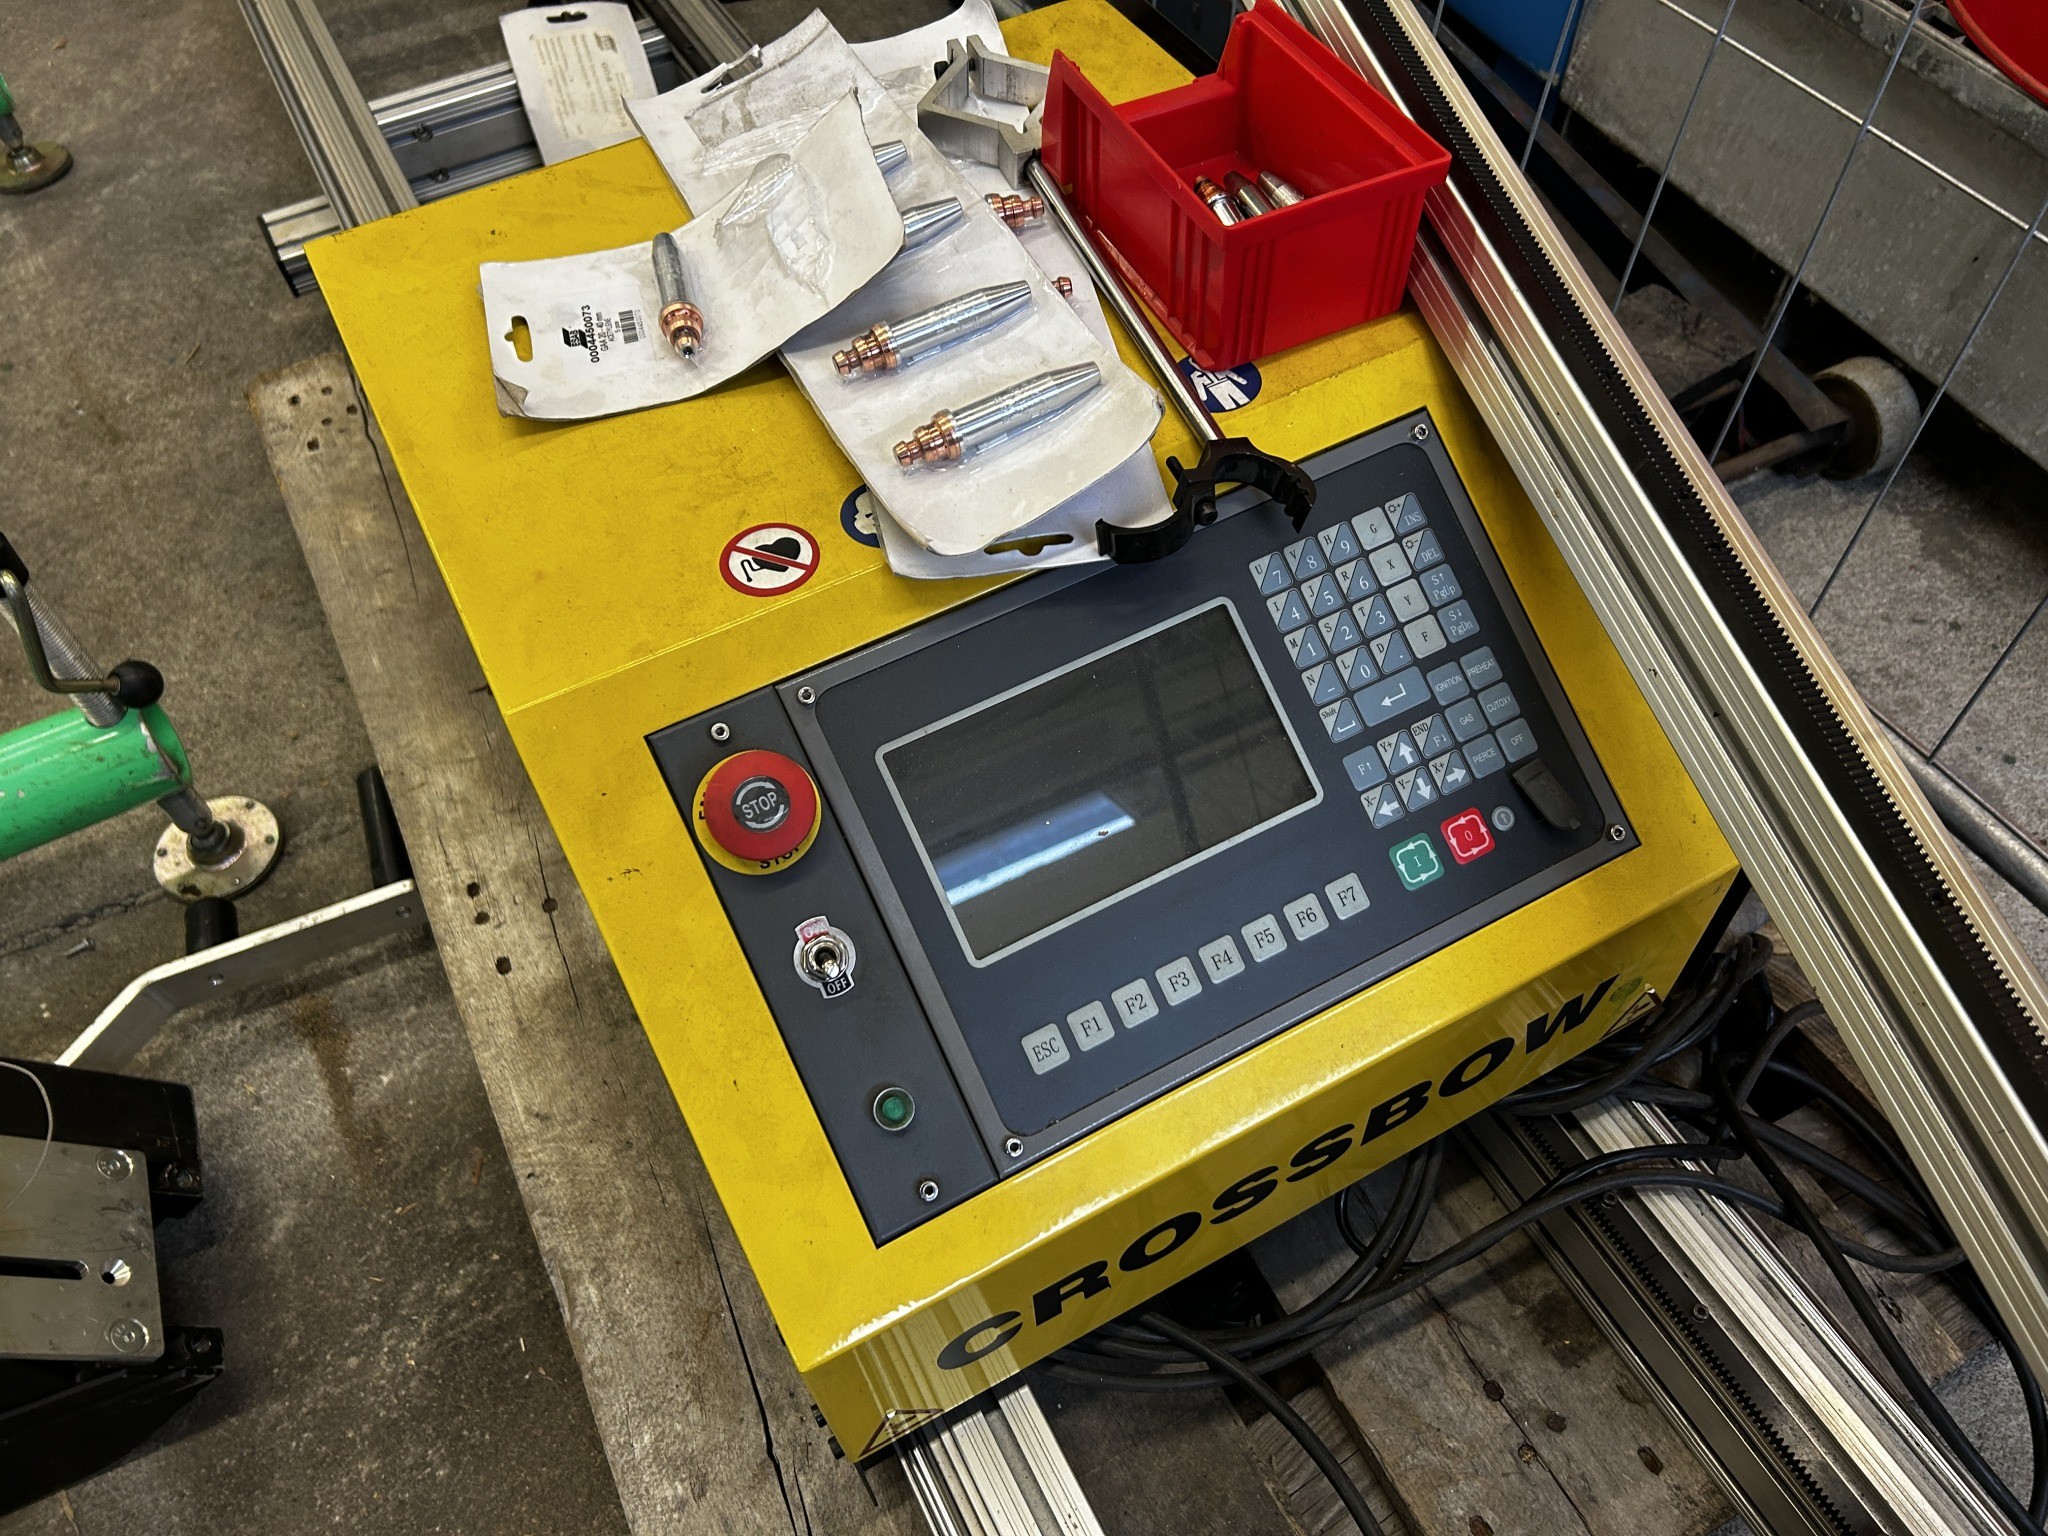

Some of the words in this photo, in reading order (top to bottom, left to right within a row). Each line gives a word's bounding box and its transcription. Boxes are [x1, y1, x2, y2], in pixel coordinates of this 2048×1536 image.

[570, 329, 581, 347] ESAB
[581, 304, 600, 363] 0004450073
[1404, 511, 1422, 526] INS
[1369, 523, 1378, 534] G
[1323, 534, 1333, 545] H
[1341, 540, 1350, 554] 9
[1289, 550, 1297, 560] V
[1306, 555, 1317, 570] 8
[1421, 547, 1440, 563] DEL
[1255, 564, 1263, 575] U
[1387, 559, 1396, 570] X
[1273, 570, 1282, 584] 7
[1341, 570, 1350, 581] R
[1360, 576, 1369, 590] 6
[1308, 585, 1315, 598] J
[1323, 591, 1334, 606] 5
[1433, 585, 1456, 600] PgUp
[1273, 601, 1280, 612] I
[1404, 595, 1411, 606] Y
[1292, 607, 1300, 620] 4
[1358, 606, 1366, 617] T
[1375, 610, 1386, 625] 3
[1324, 622, 1332, 633] S
[1341, 626, 1353, 640] 2
[1450, 620, 1474, 636] PgDn
[1289, 638, 1299, 649] M
[1421, 631, 1428, 642] F
[1306, 642, 1316, 657] 1
[1376, 643, 1384, 653] D
[1341, 659, 1350, 670] L
[1360, 664, 1370, 679] 0
[1466, 659, 1495, 678] PREHEAT
[1306, 674, 1316, 686] N
[1435, 674, 1463, 693] IGNITION
[1486, 695, 1512, 713] CUTOXY
[1321, 707, 1337, 720] Shift
[1460, 713, 1474, 726] GAS
[1411, 722, 1429, 737] END
[1380, 741, 1393, 753] Y+
[1510, 733, 1523, 746] OFF
[1472, 747, 1497, 764] PIERCE
[1431, 762, 1445, 774] X+
[741, 791, 778, 819] STOP
[1337, 886, 1356, 907] F7
[1295, 907, 1317, 928] F6
[1253, 927, 1276, 949] F5
[1211, 949, 1235, 971] F4
[827, 977, 848, 994] OFF
[1168, 971, 1190, 993] F3
[1124, 993, 1148, 1015] F2
[1080, 1016, 1103, 1038] F1
[1032, 1036, 1060, 1063] ESC
[937, 973, 1621, 1370] CROSSBOW
